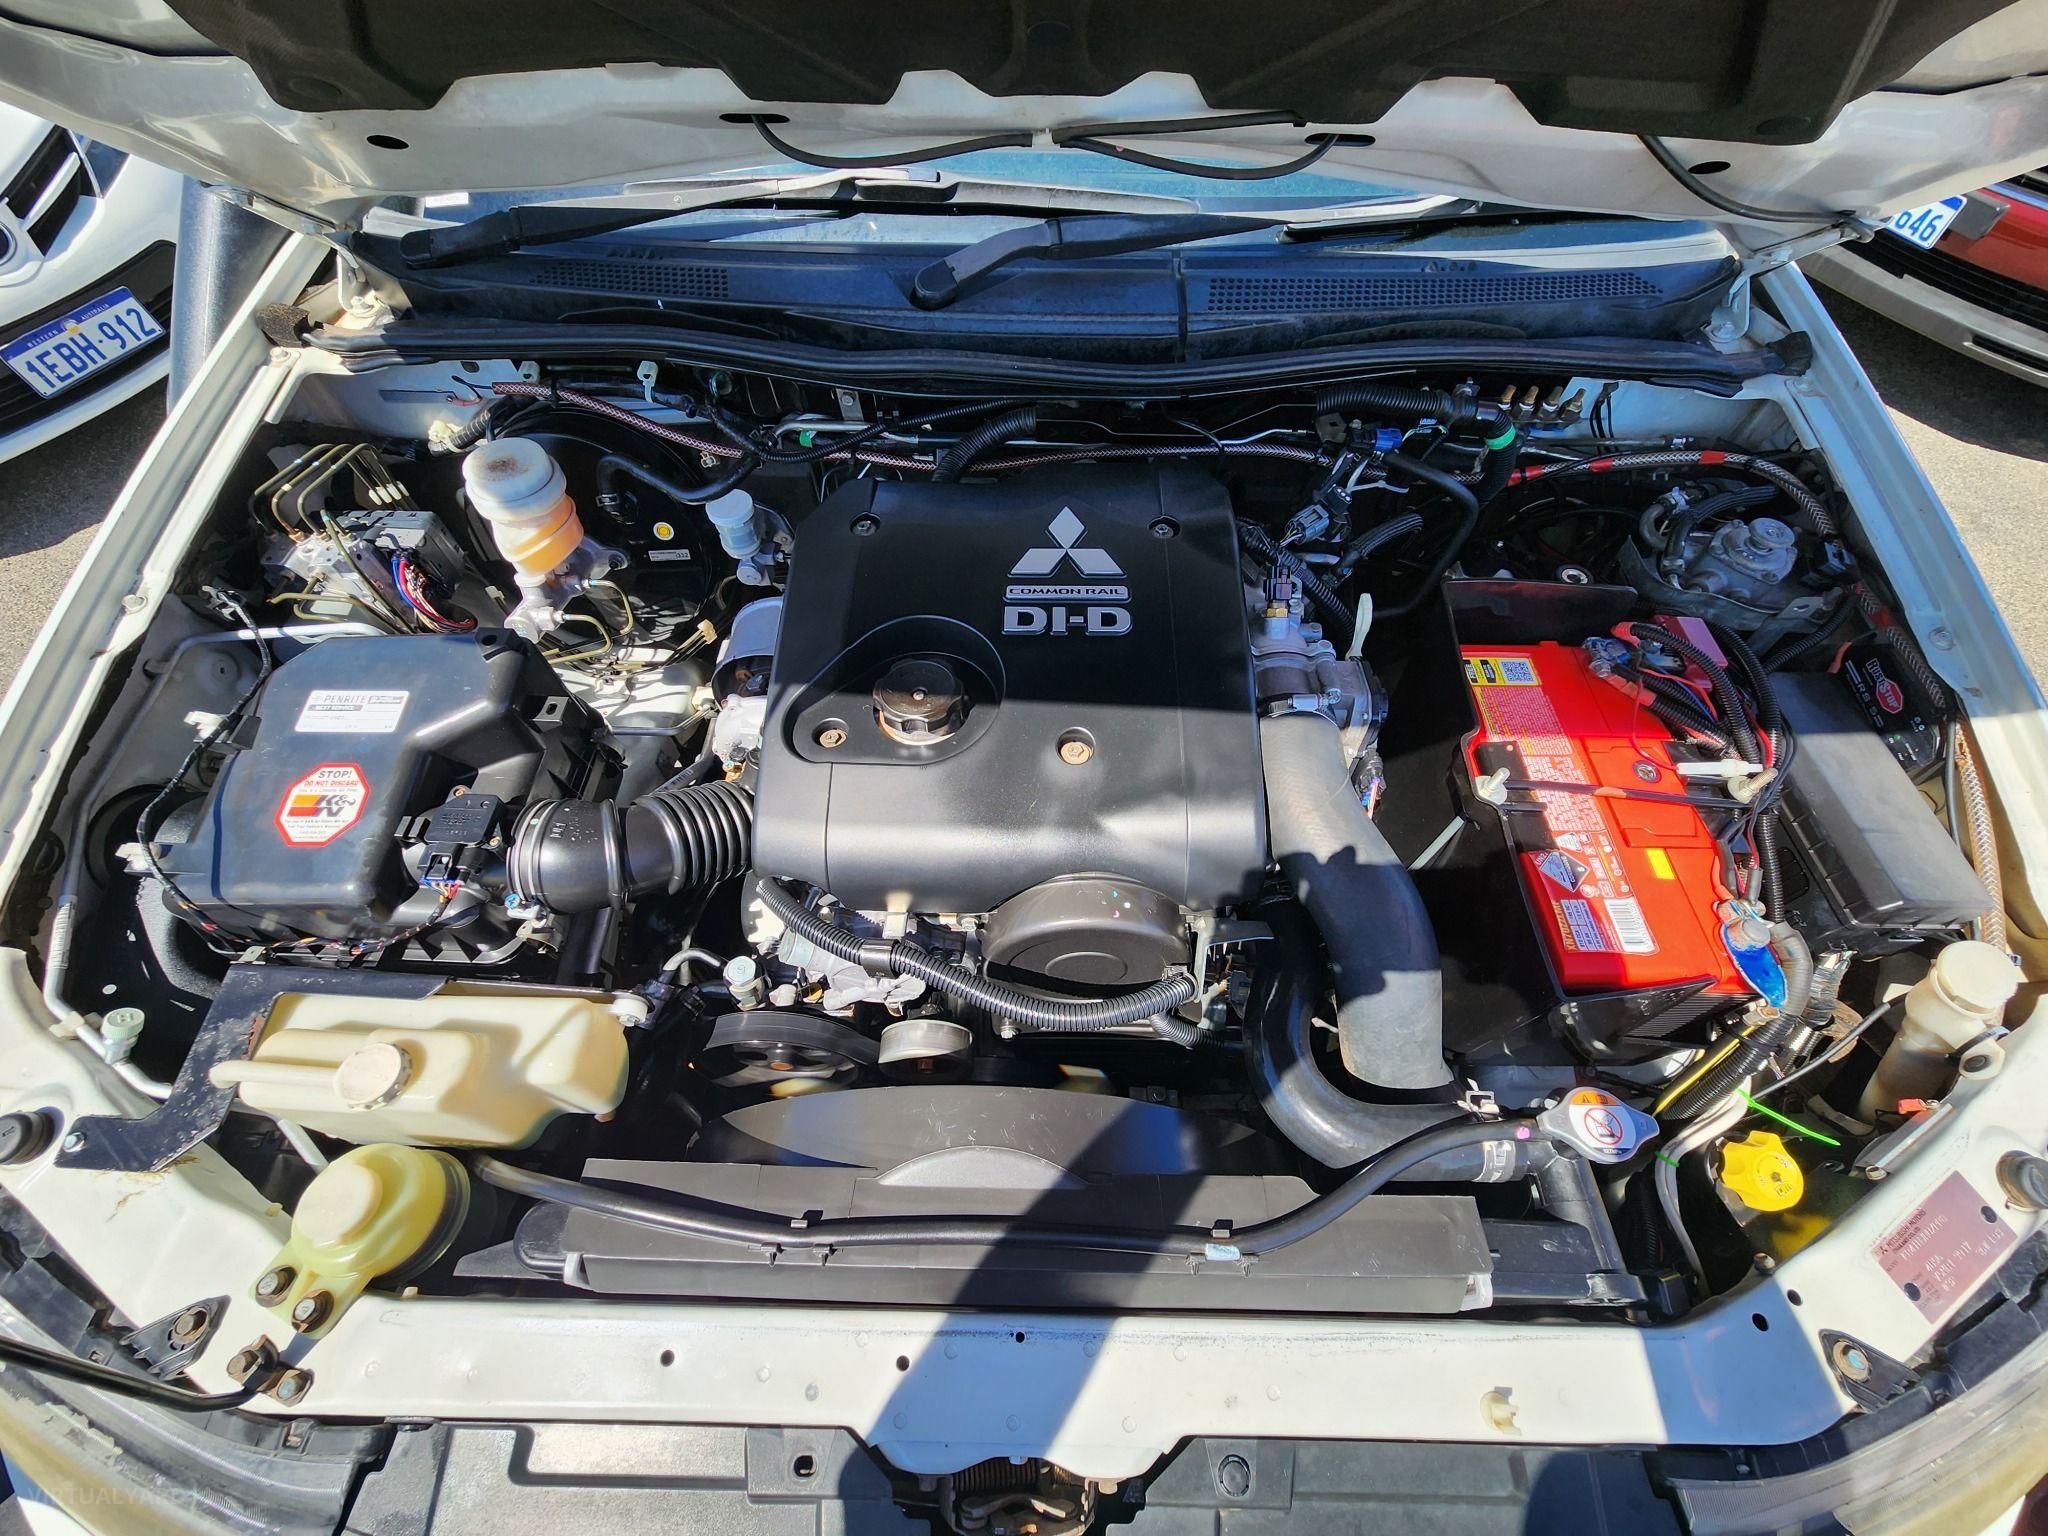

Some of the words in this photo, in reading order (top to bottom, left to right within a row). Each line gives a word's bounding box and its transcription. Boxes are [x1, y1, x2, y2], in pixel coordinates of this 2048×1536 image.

[81, 303, 110, 321] AUSTRALIA
[1003, 606, 1133, 636] DI-D
[324, 694, 367, 704] PENRITE
[318, 770, 353, 779] STOP!
